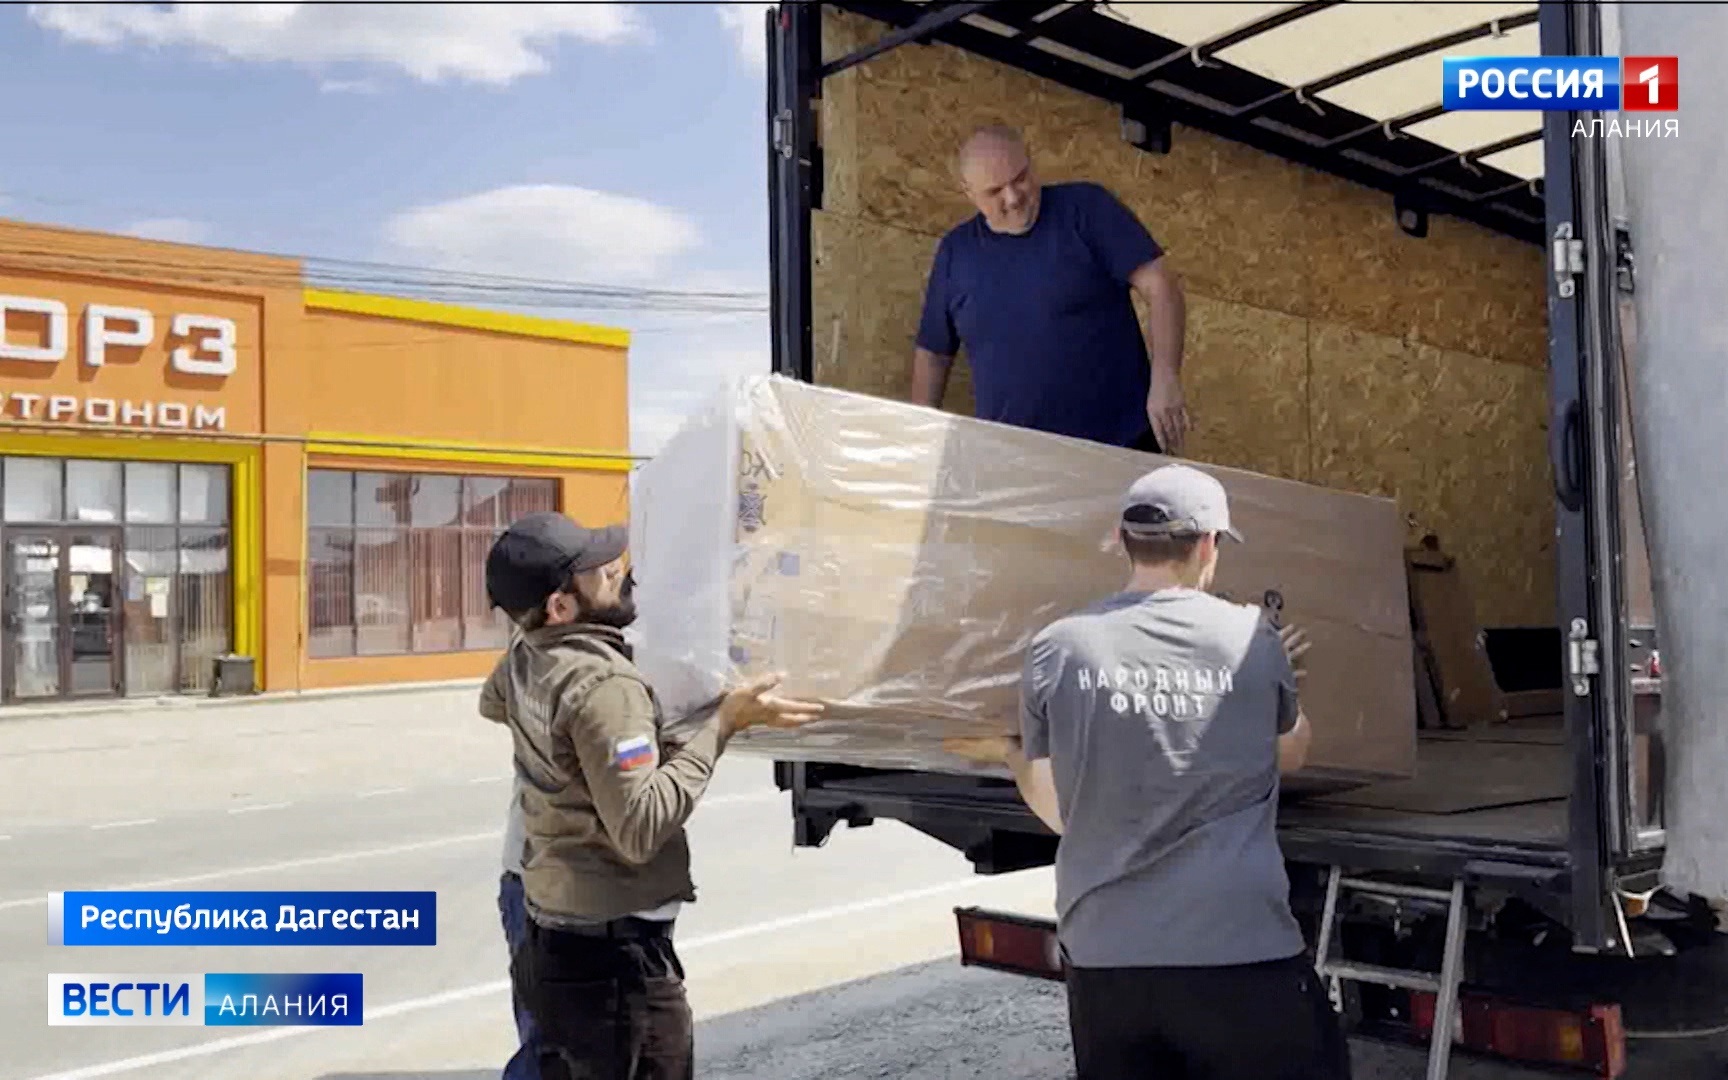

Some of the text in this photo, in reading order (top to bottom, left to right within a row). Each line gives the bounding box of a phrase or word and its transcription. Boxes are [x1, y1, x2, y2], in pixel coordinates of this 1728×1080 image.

[0, 392, 226, 431] ТРОНОМ
[1077, 664, 1234, 693] НАРОДНЫЙ
[1110, 691, 1206, 715] ФРОНТ
